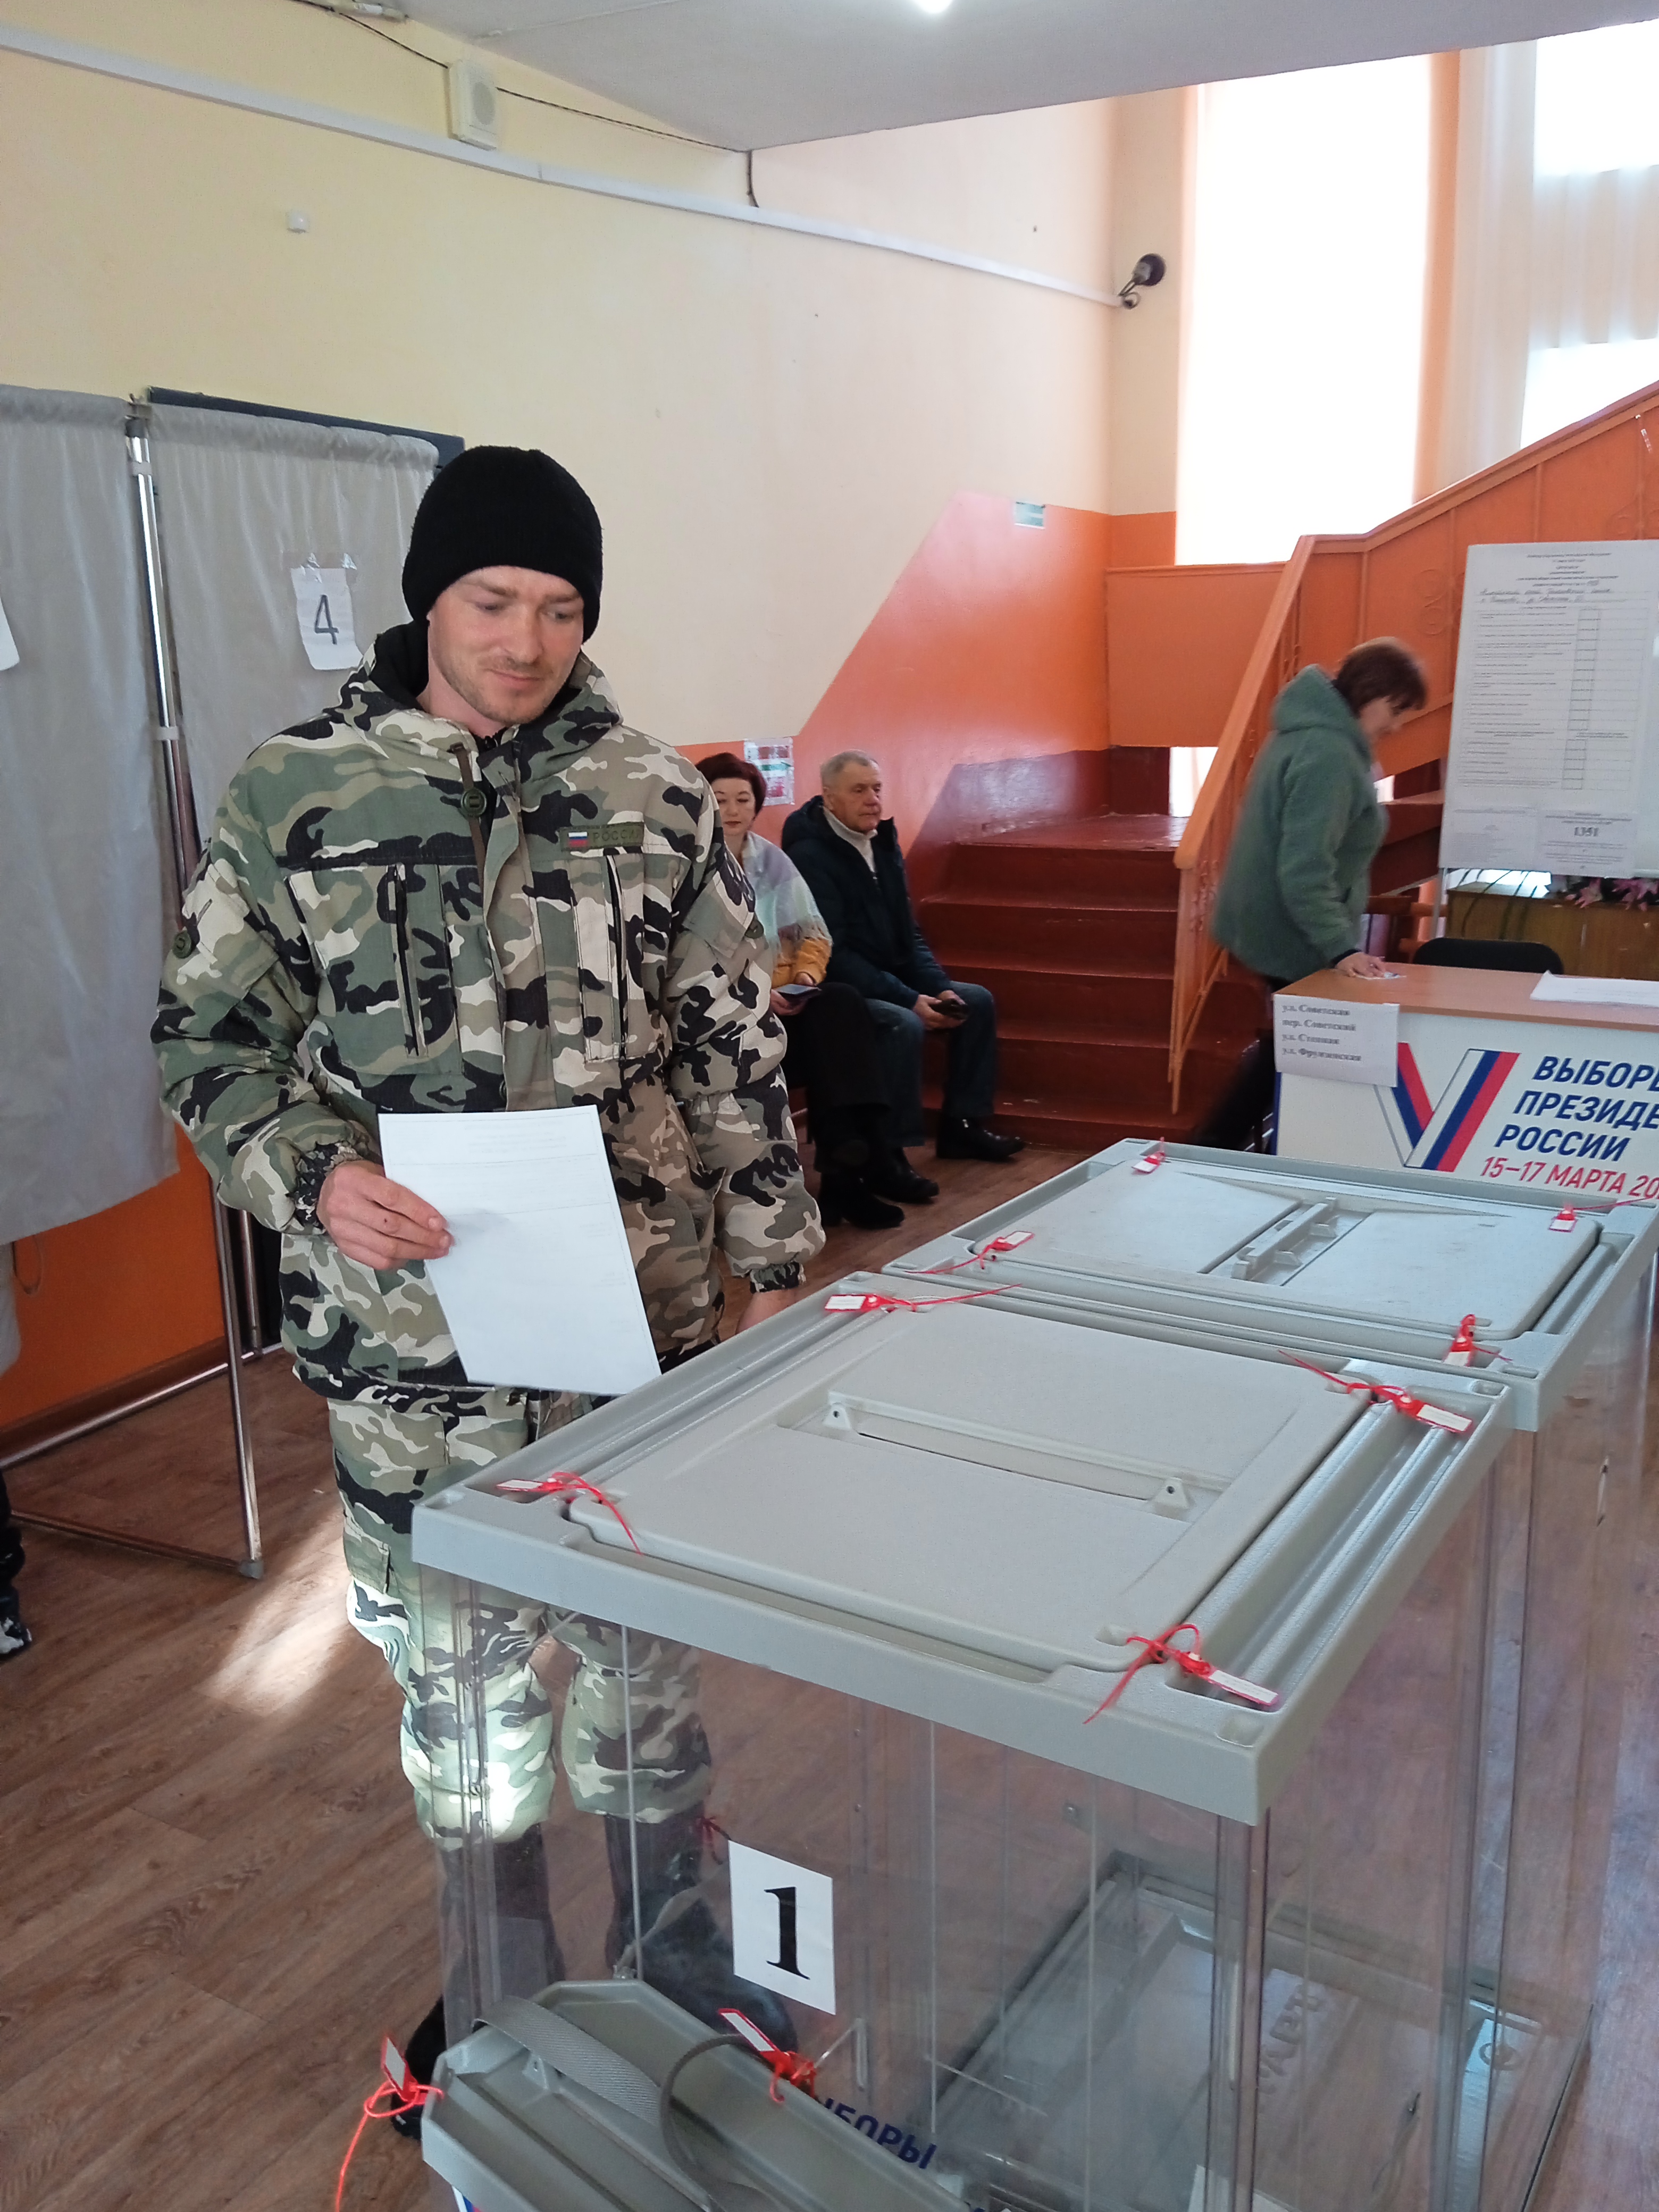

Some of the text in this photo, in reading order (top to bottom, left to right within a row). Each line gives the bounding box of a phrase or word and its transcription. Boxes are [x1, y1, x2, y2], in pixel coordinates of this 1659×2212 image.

[314, 594, 339, 644] 4
[1512, 1090, 1659, 1131] ПРЕЗИДЕ
[1494, 1124, 1631, 1161] РОССИИ
[1544, 1164, 1627, 1194] МАРТА
[1627, 1175, 1659, 1200] 20
[764, 1886, 811, 1980] 1
